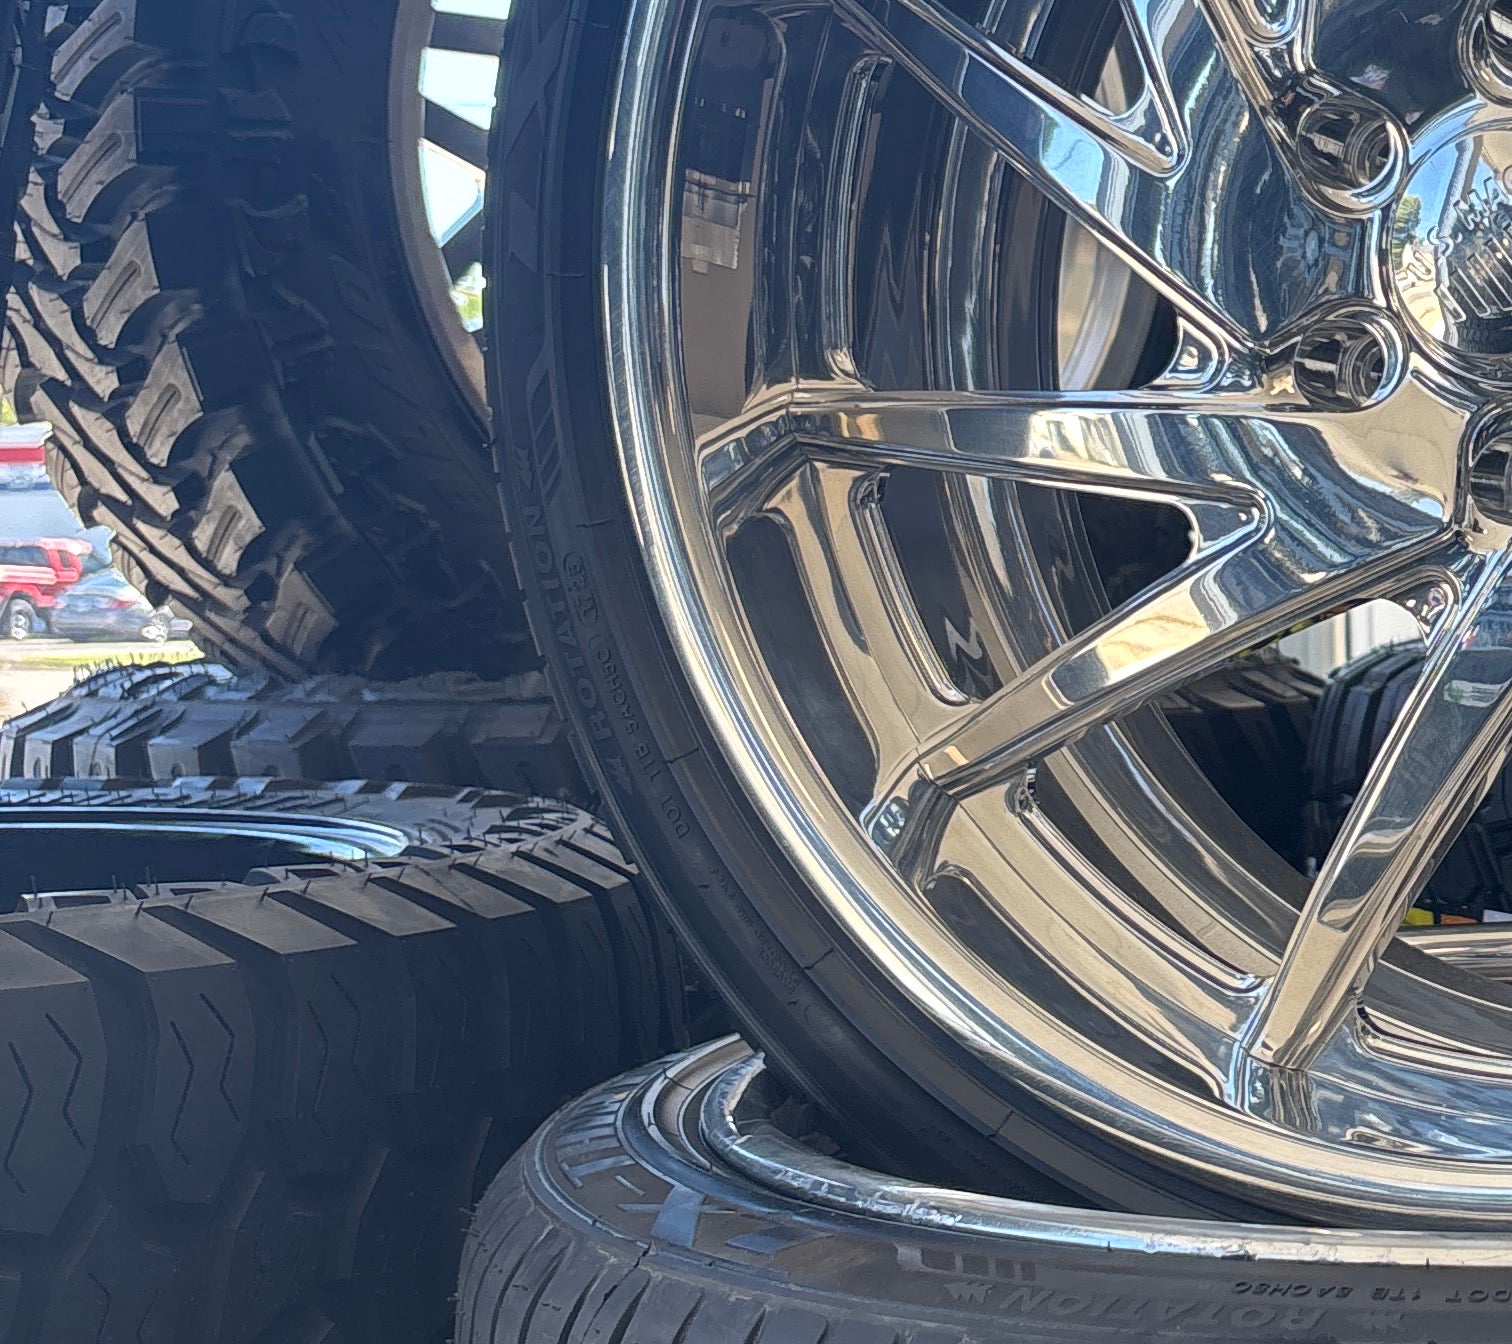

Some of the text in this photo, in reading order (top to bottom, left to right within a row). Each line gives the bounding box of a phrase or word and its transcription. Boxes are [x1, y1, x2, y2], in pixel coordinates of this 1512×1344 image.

[522, 505, 615, 741] ROTATION
[661, 794, 690, 837] DOT
[999, 1288, 1330, 1333] ROTATION
[1445, 1289, 1512, 1304] DOT
